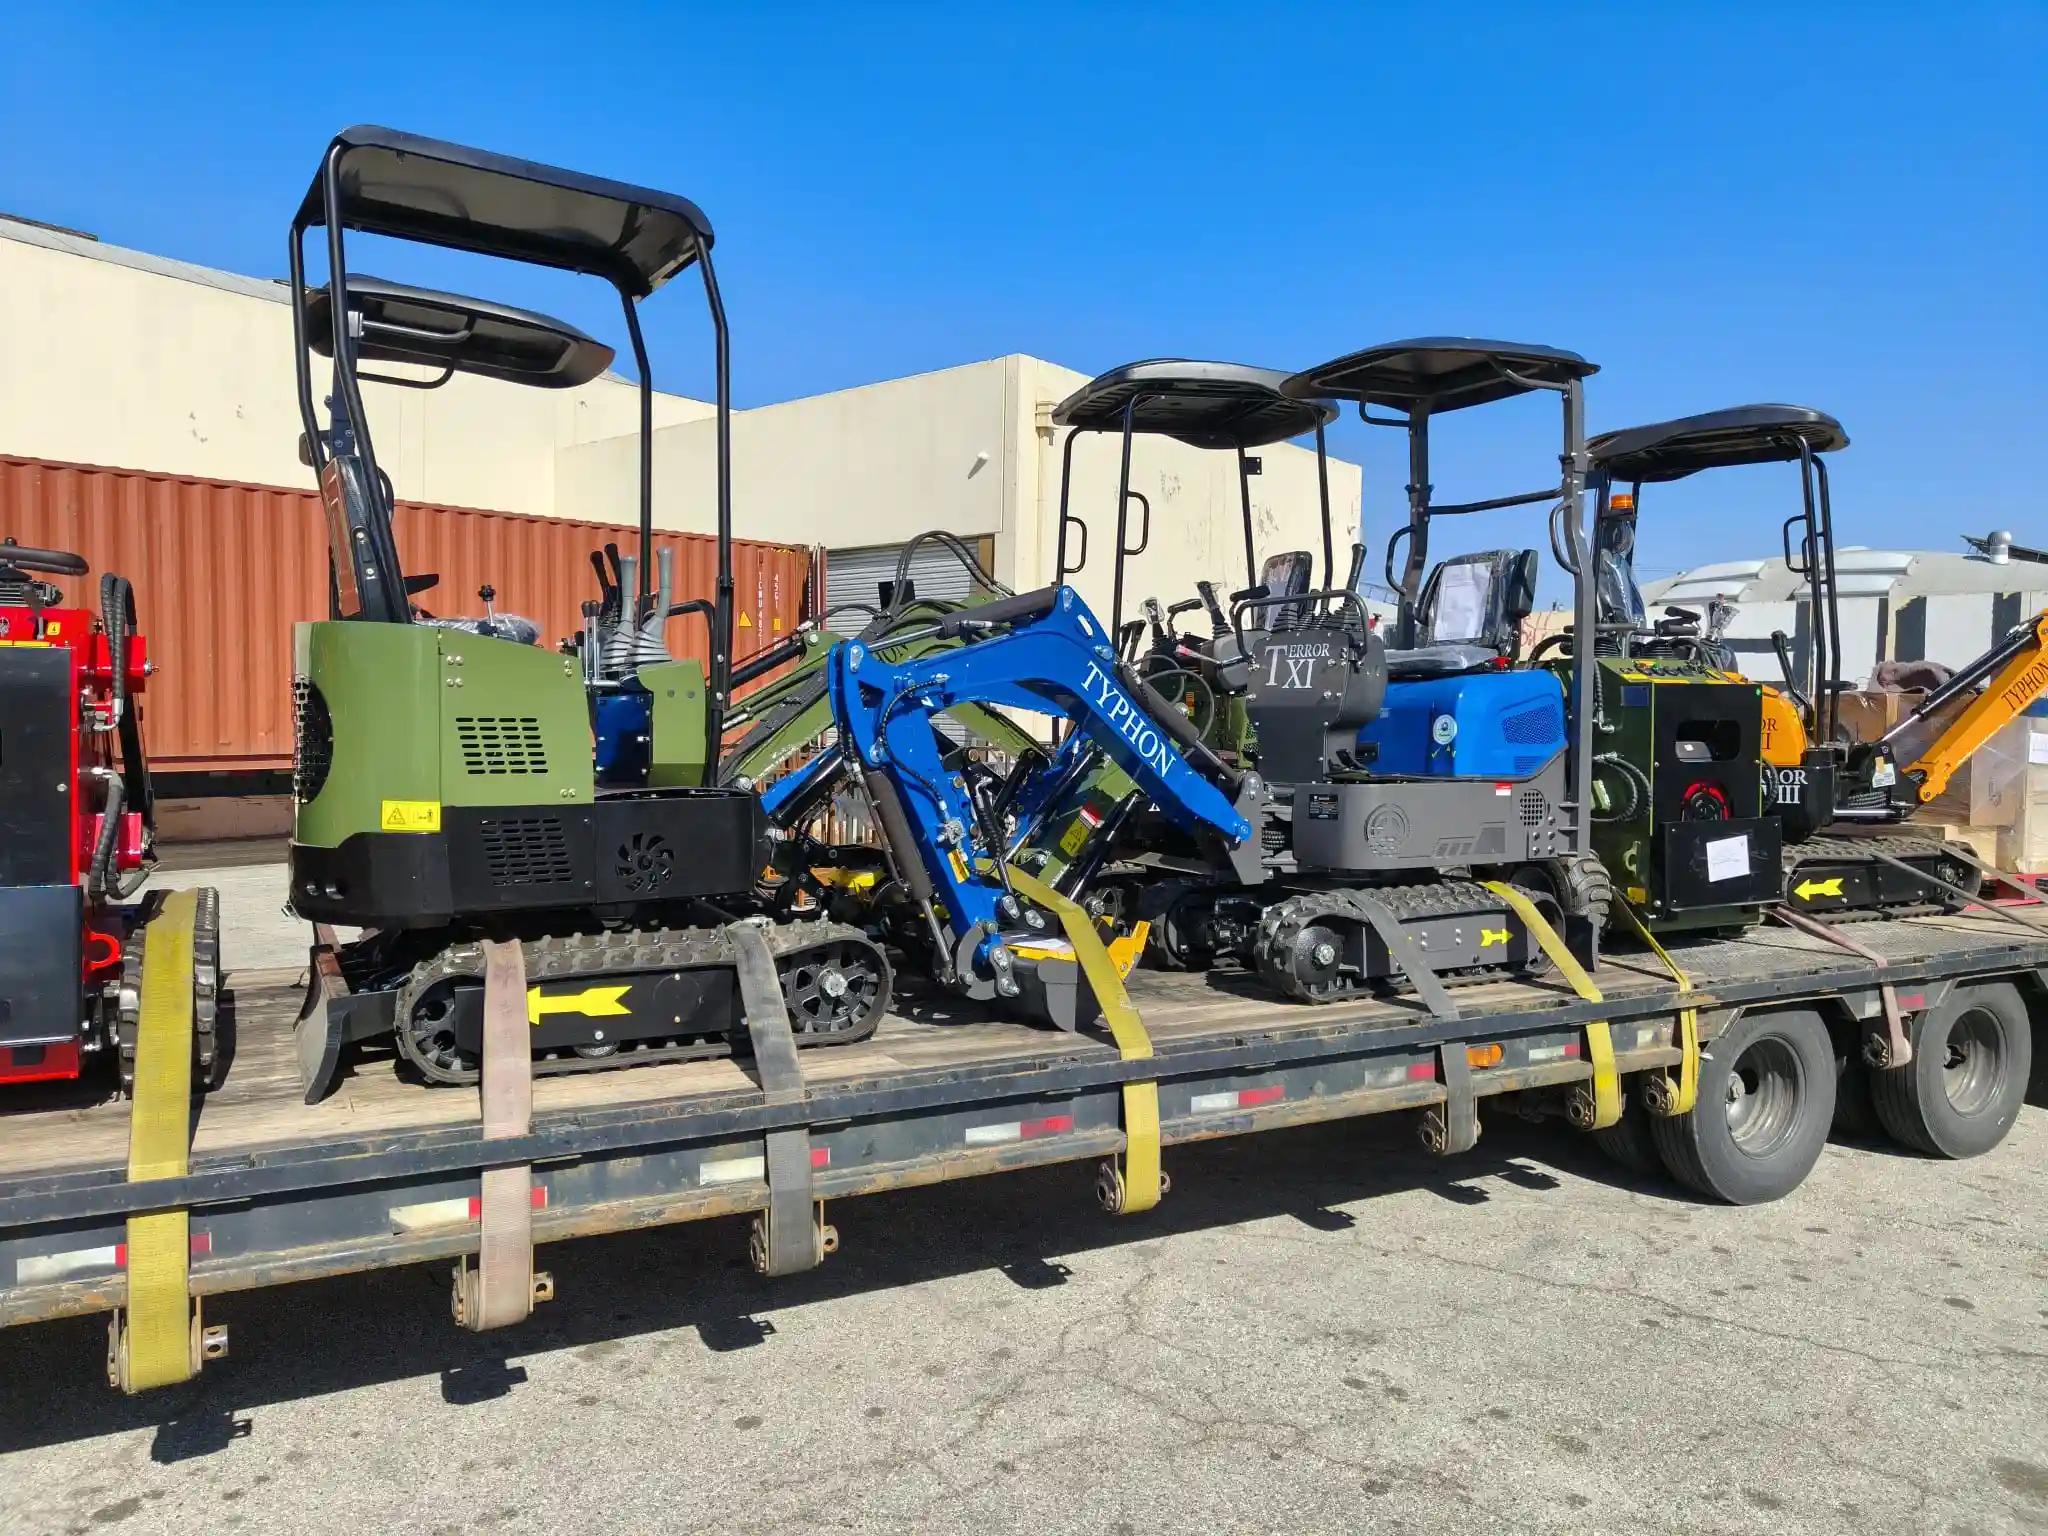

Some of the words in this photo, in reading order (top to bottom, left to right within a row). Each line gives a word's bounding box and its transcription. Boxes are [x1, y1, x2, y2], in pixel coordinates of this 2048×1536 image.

[1264, 643, 1330, 687] TERROR
[1281, 658, 1317, 689] XI
[1081, 661, 1176, 778] TYPHON
